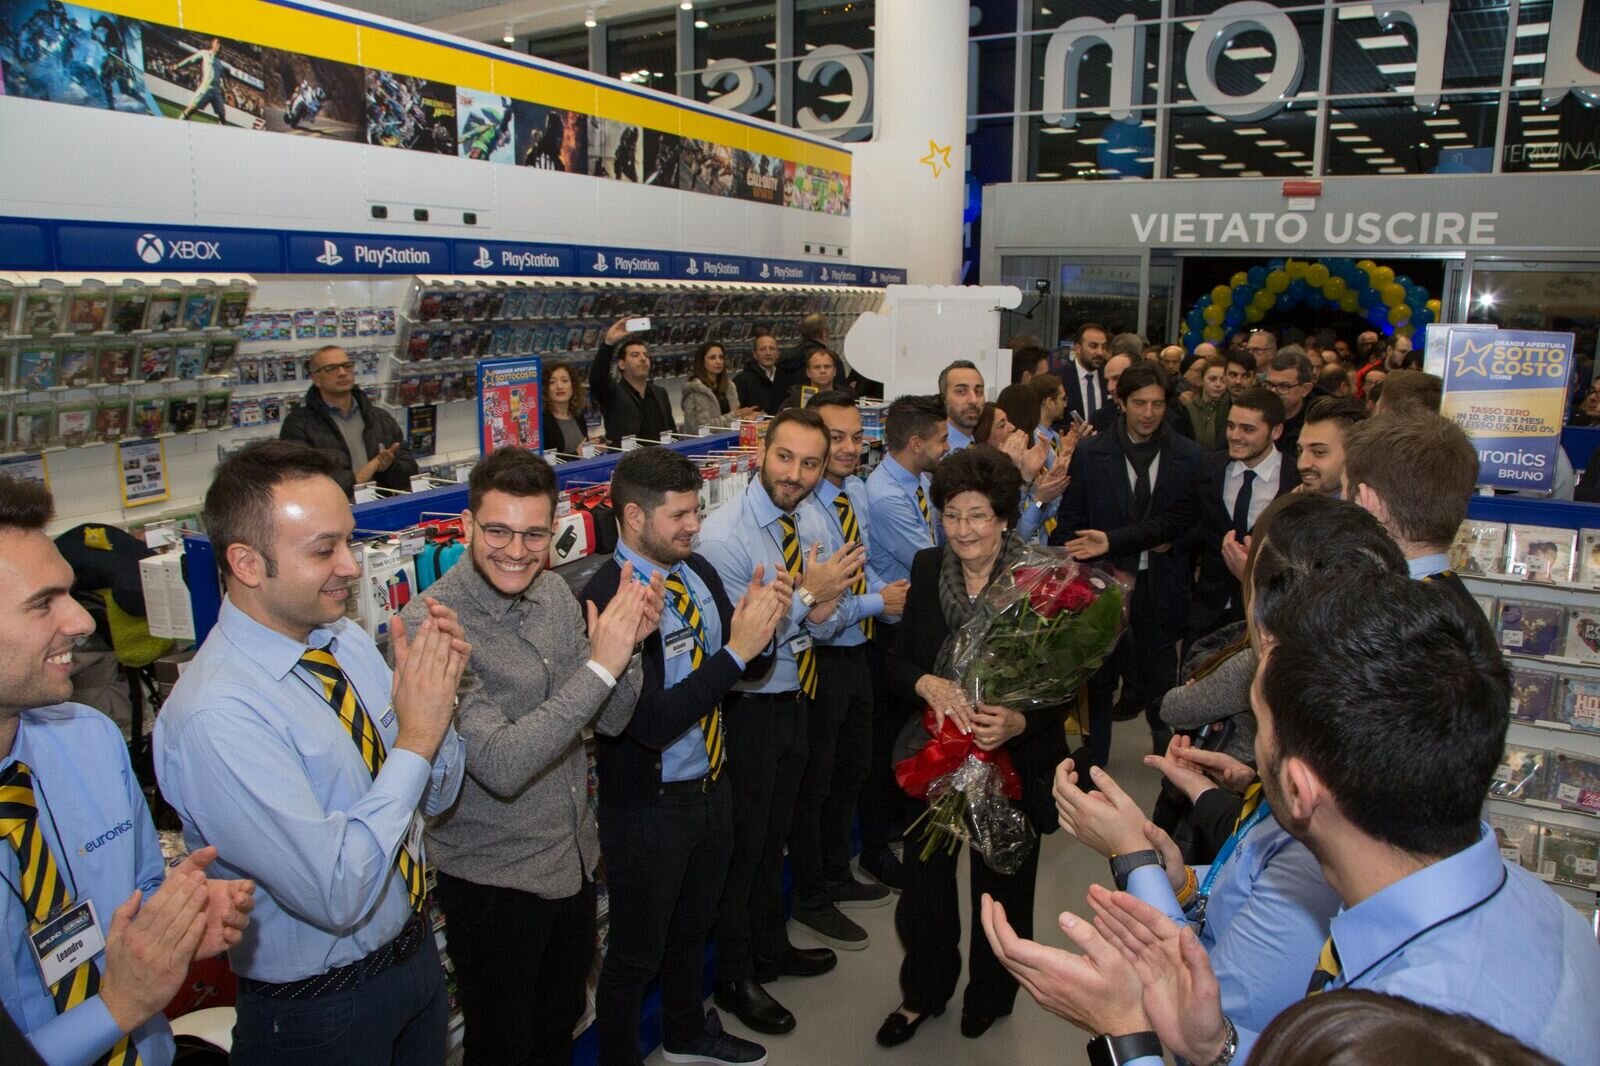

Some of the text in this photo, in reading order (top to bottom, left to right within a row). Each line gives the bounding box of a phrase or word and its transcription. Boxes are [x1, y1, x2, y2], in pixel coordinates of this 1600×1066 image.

[1503, 141, 1600, 162] TERMINA
[1131, 212, 1499, 244] VIETATO USCIRE
[169, 240, 221, 260] XBOX
[355, 246, 430, 268] PlayStation
[502, 252, 560, 271] PlayStation
[615, 257, 660, 274] PlayStation
[704, 261, 740, 275] PlayStation
[774, 266, 803, 279] PlayStation
[831, 270, 857, 282] PlayStation
[1526, 341, 1566, 349] APERTURA
[1493, 346, 1565, 363] SOTTO
[495, 371, 537, 381] SOTTOCOSTO
[1491, 360, 1564, 378] COSTO
[1470, 406, 1530, 417] TASSO ZERO
[1483, 414, 1495, 422] 20
[1520, 417, 1544, 425] MESI
[1495, 422, 1510, 431] 0%
[1513, 424, 1538, 432] TAEG
[1539, 425, 1555, 434] 0%
[1498, 468, 1544, 481] BRUNO
[85, 819, 133, 853] euronics
[39, 930, 62, 950] BRUNO
[56, 939, 84, 963] Leandro
